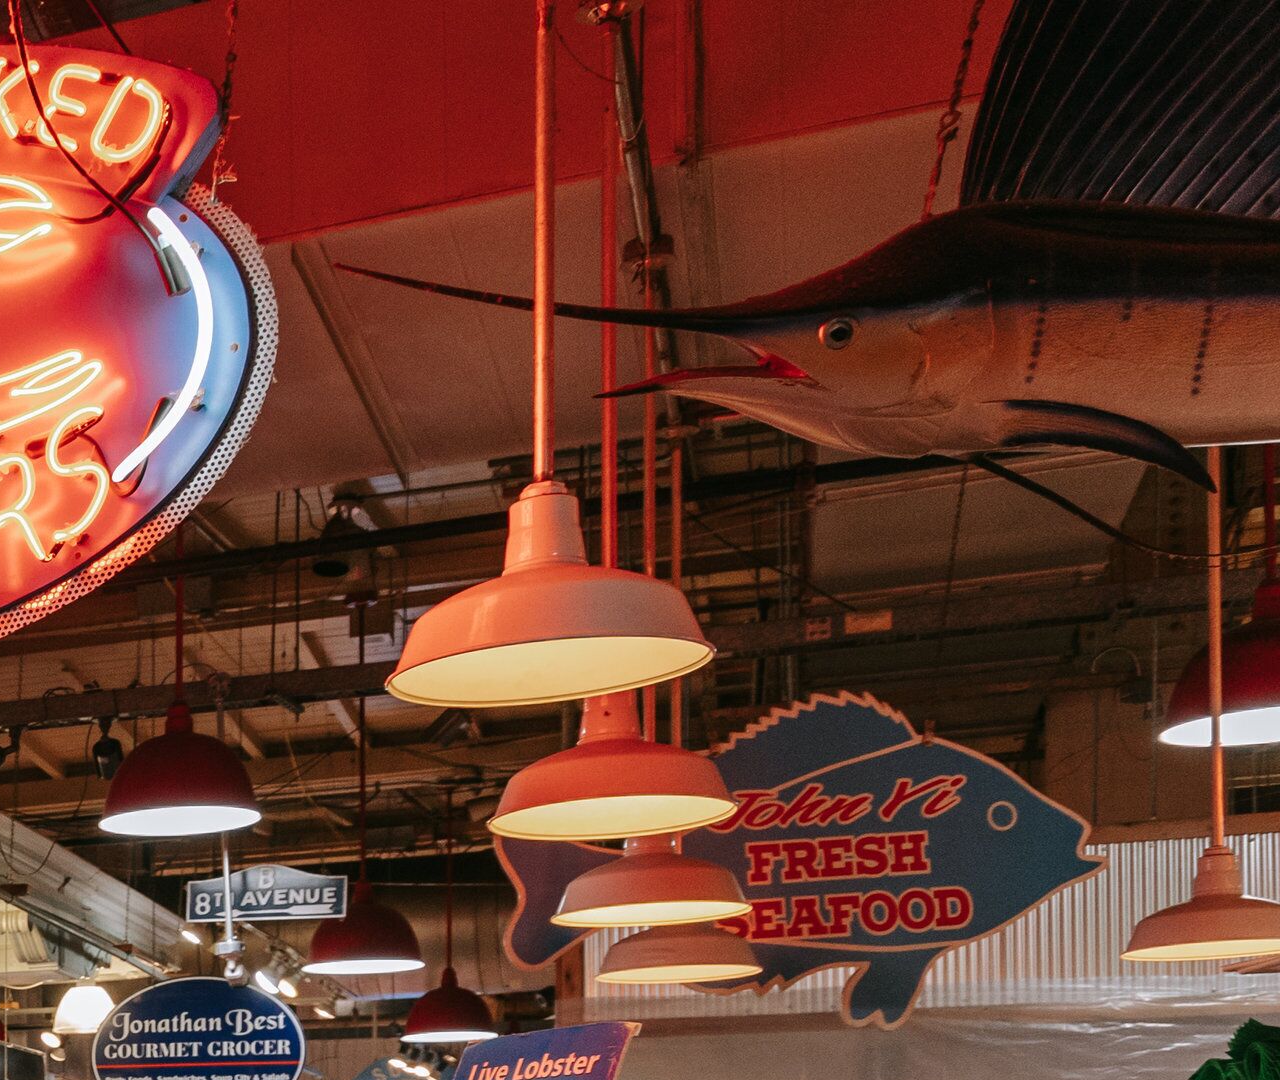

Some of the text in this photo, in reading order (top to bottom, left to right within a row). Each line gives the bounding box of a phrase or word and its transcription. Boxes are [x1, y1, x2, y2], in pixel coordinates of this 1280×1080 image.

[706, 774, 968, 834] John Yi
[746, 830, 930, 886] FRESH
[258, 867, 276, 889] B
[240, 886, 337, 907] AVENUE
[110, 1007, 287, 1043] Jonathan Best
[103, 1038, 292, 1060] GOURMET GROCER
